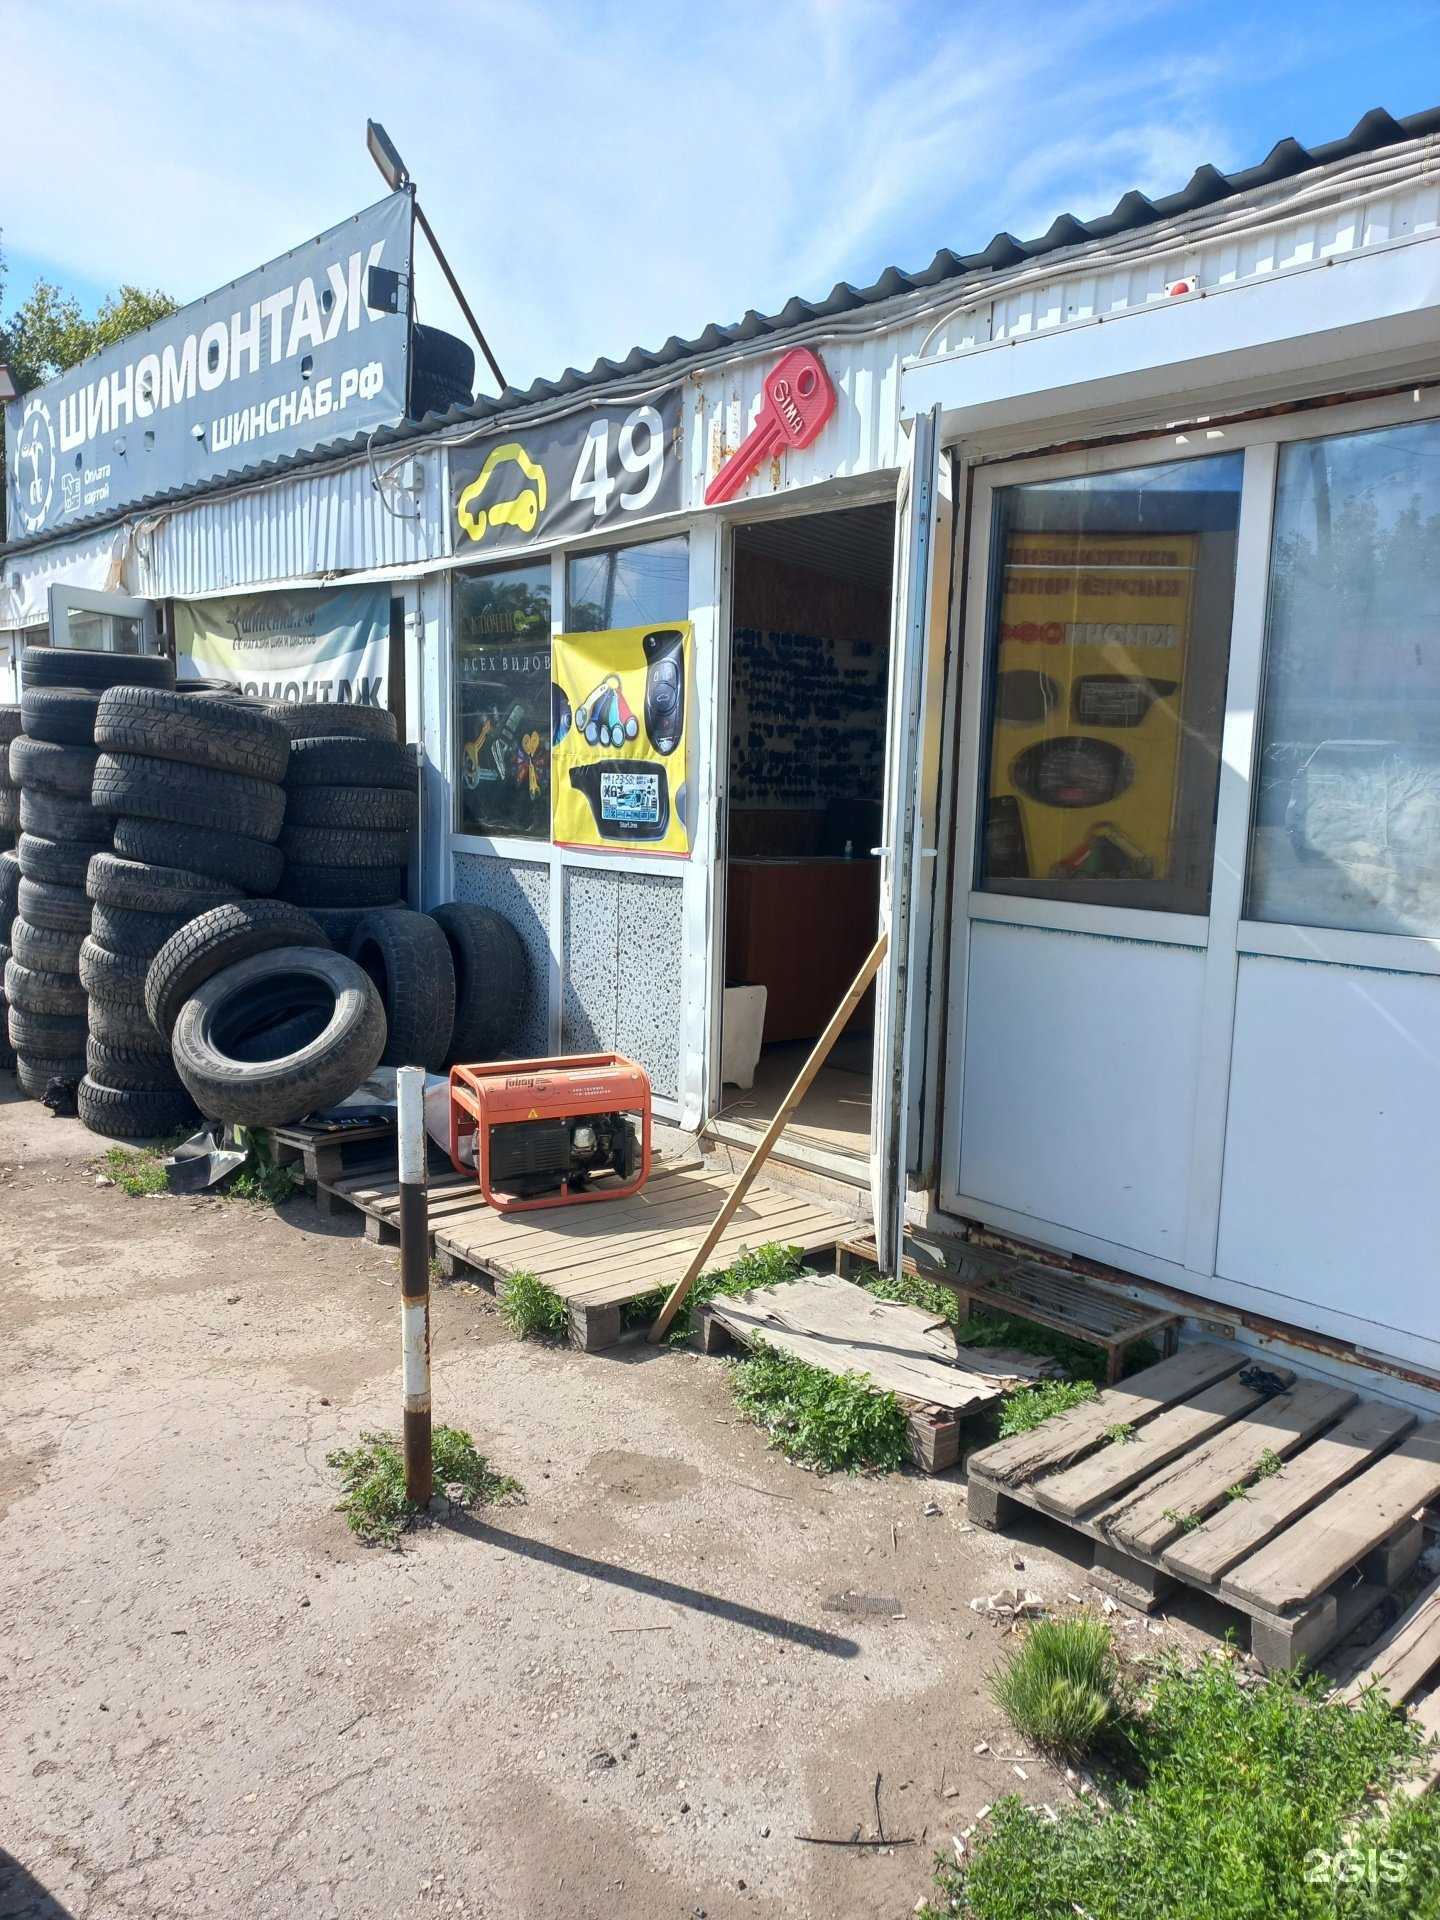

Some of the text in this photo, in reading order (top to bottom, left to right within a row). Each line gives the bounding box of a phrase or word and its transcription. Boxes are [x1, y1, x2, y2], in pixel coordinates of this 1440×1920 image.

[60, 240, 386, 453] ШИНОМОНТАЖ
[211, 361, 385, 453] ШИНСНАБ.РФ
[84, 464, 111, 485] Оплата
[569, 405, 665, 517] 49
[238, 677, 382, 706] ОМОНТАЖ
[464, 655, 551, 672] ВСЕХ ВИДОВ
